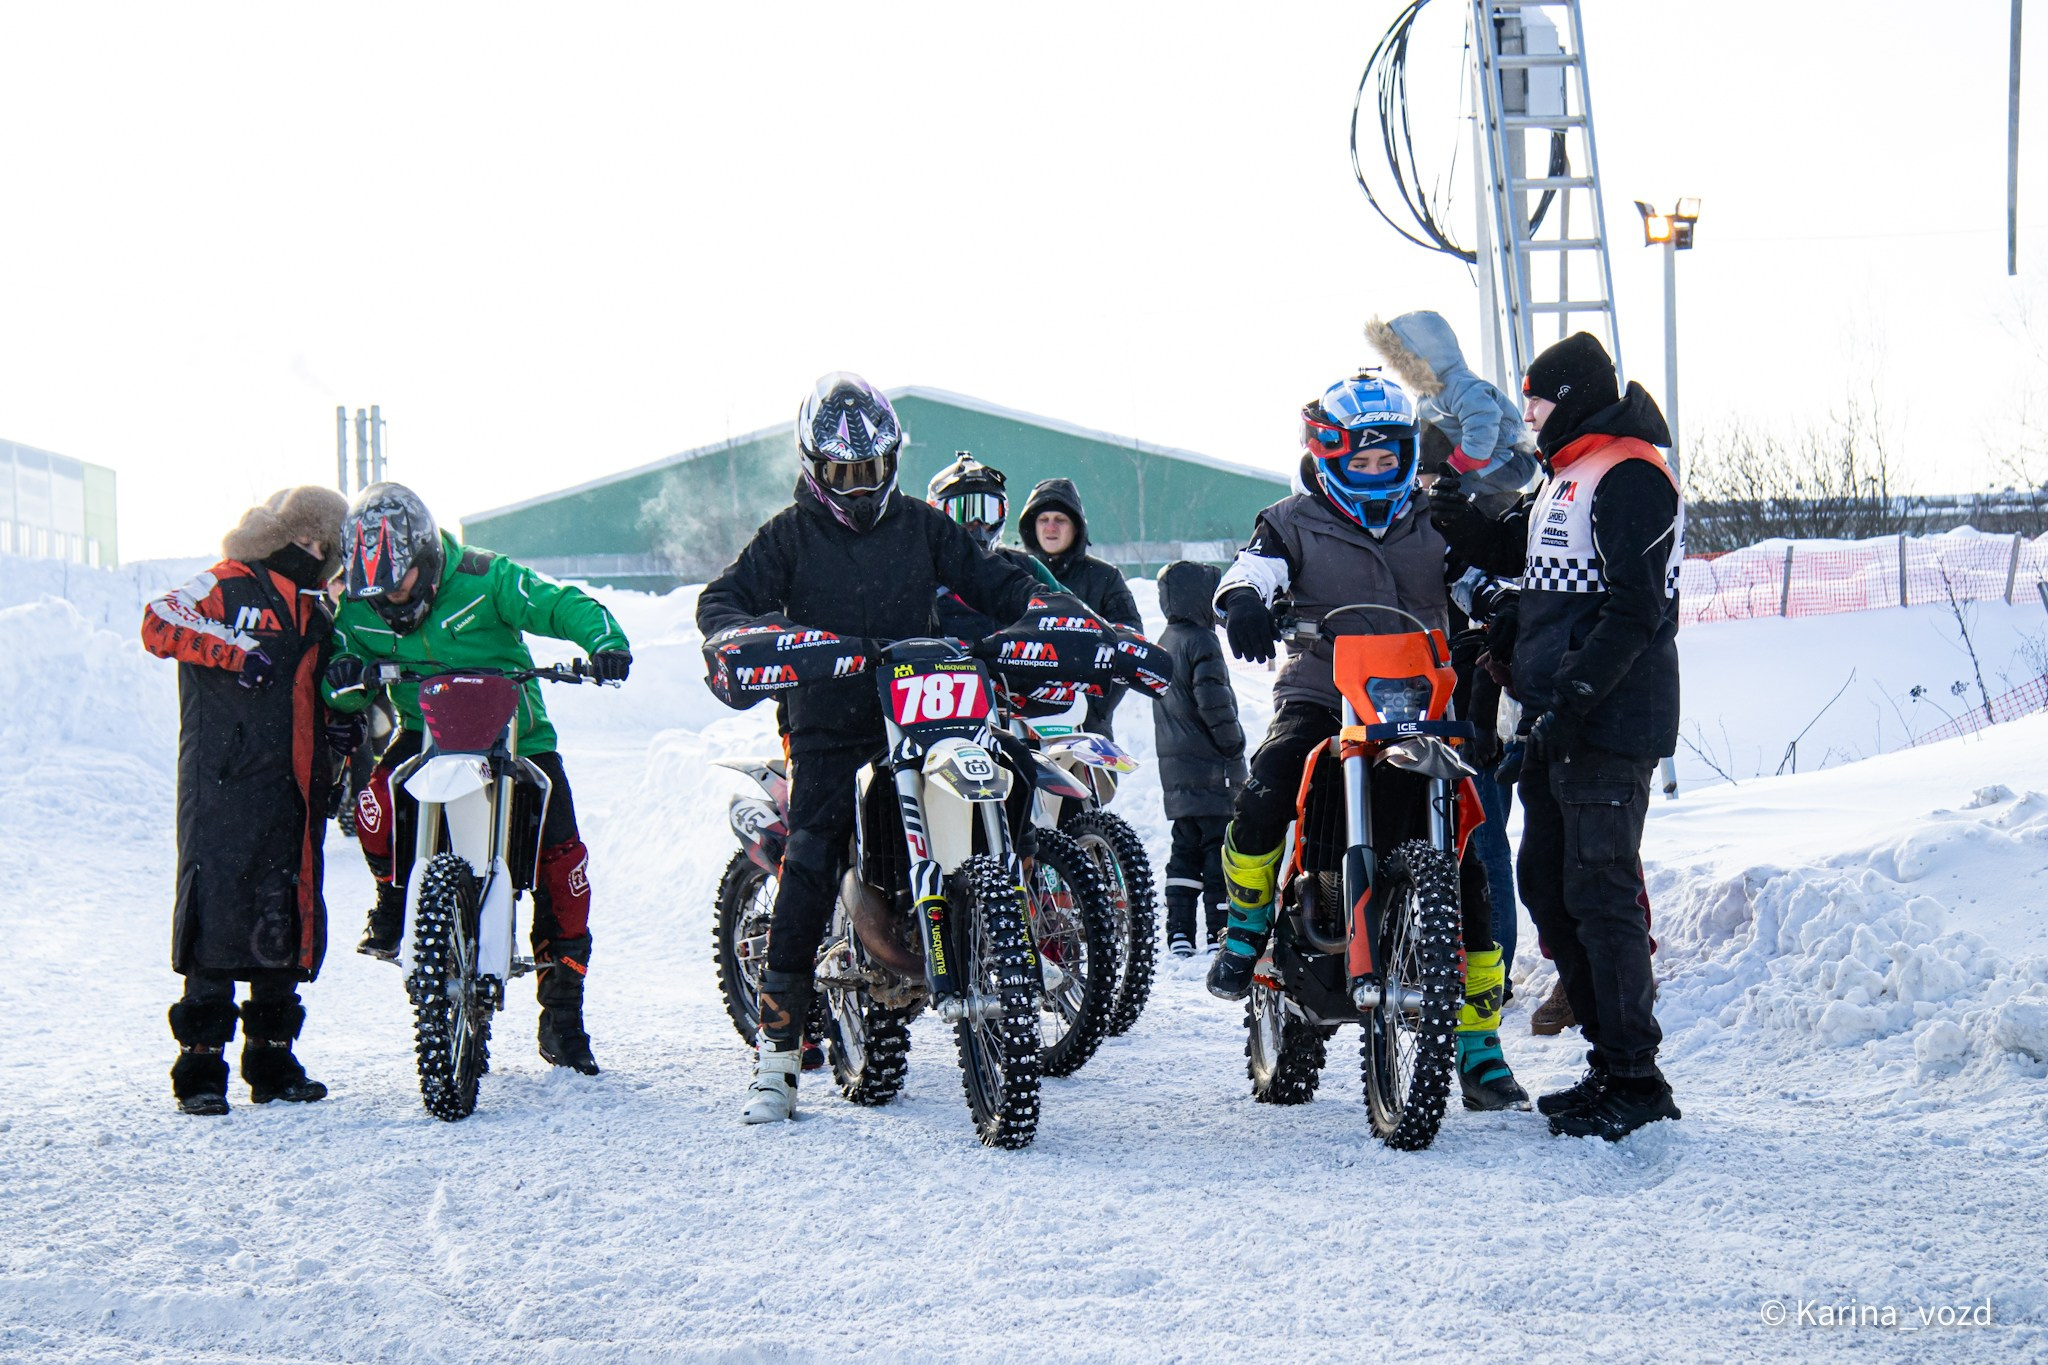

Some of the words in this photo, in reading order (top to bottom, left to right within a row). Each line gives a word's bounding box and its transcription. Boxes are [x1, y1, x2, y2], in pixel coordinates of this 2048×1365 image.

[1350, 411, 1409, 425] LEATT
[821, 441, 853, 460] Airoh
[1542, 527, 1568, 537] Mitas
[934, 663, 977, 671] Husqvarna
[897, 673, 979, 725] 787
[1397, 723, 1418, 731] ICE
[932, 922, 948, 976] usqvarna
